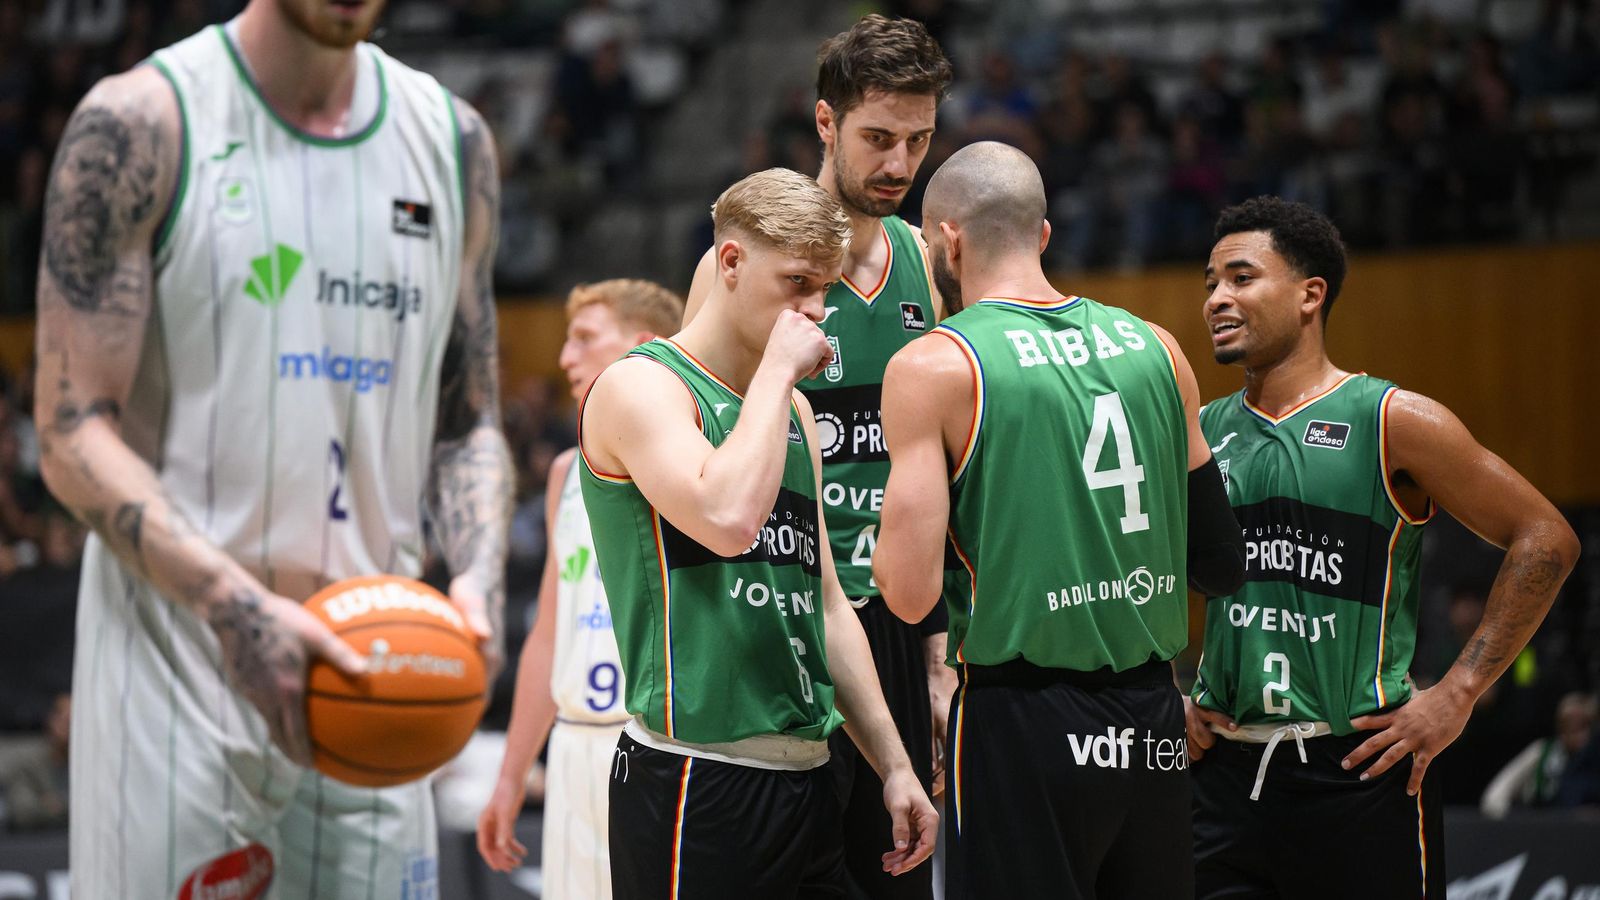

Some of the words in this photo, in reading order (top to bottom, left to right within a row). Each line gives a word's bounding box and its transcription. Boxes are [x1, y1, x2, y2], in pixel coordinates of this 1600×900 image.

[1004, 320, 1146, 367] RIBAS
[280, 346, 391, 393] mlaga
[1308, 435, 1343, 446] endesa
[1310, 427, 1327, 437] liga
[1082, 391, 1149, 534] 4
[1245, 539, 1343, 585] PROBTAS
[1047, 579, 1129, 612] BADLON
[1224, 601, 1336, 642] OVENTT
[586, 662, 619, 712] 9
[1263, 652, 1291, 716] 2
[1067, 726, 1135, 769] vdf
